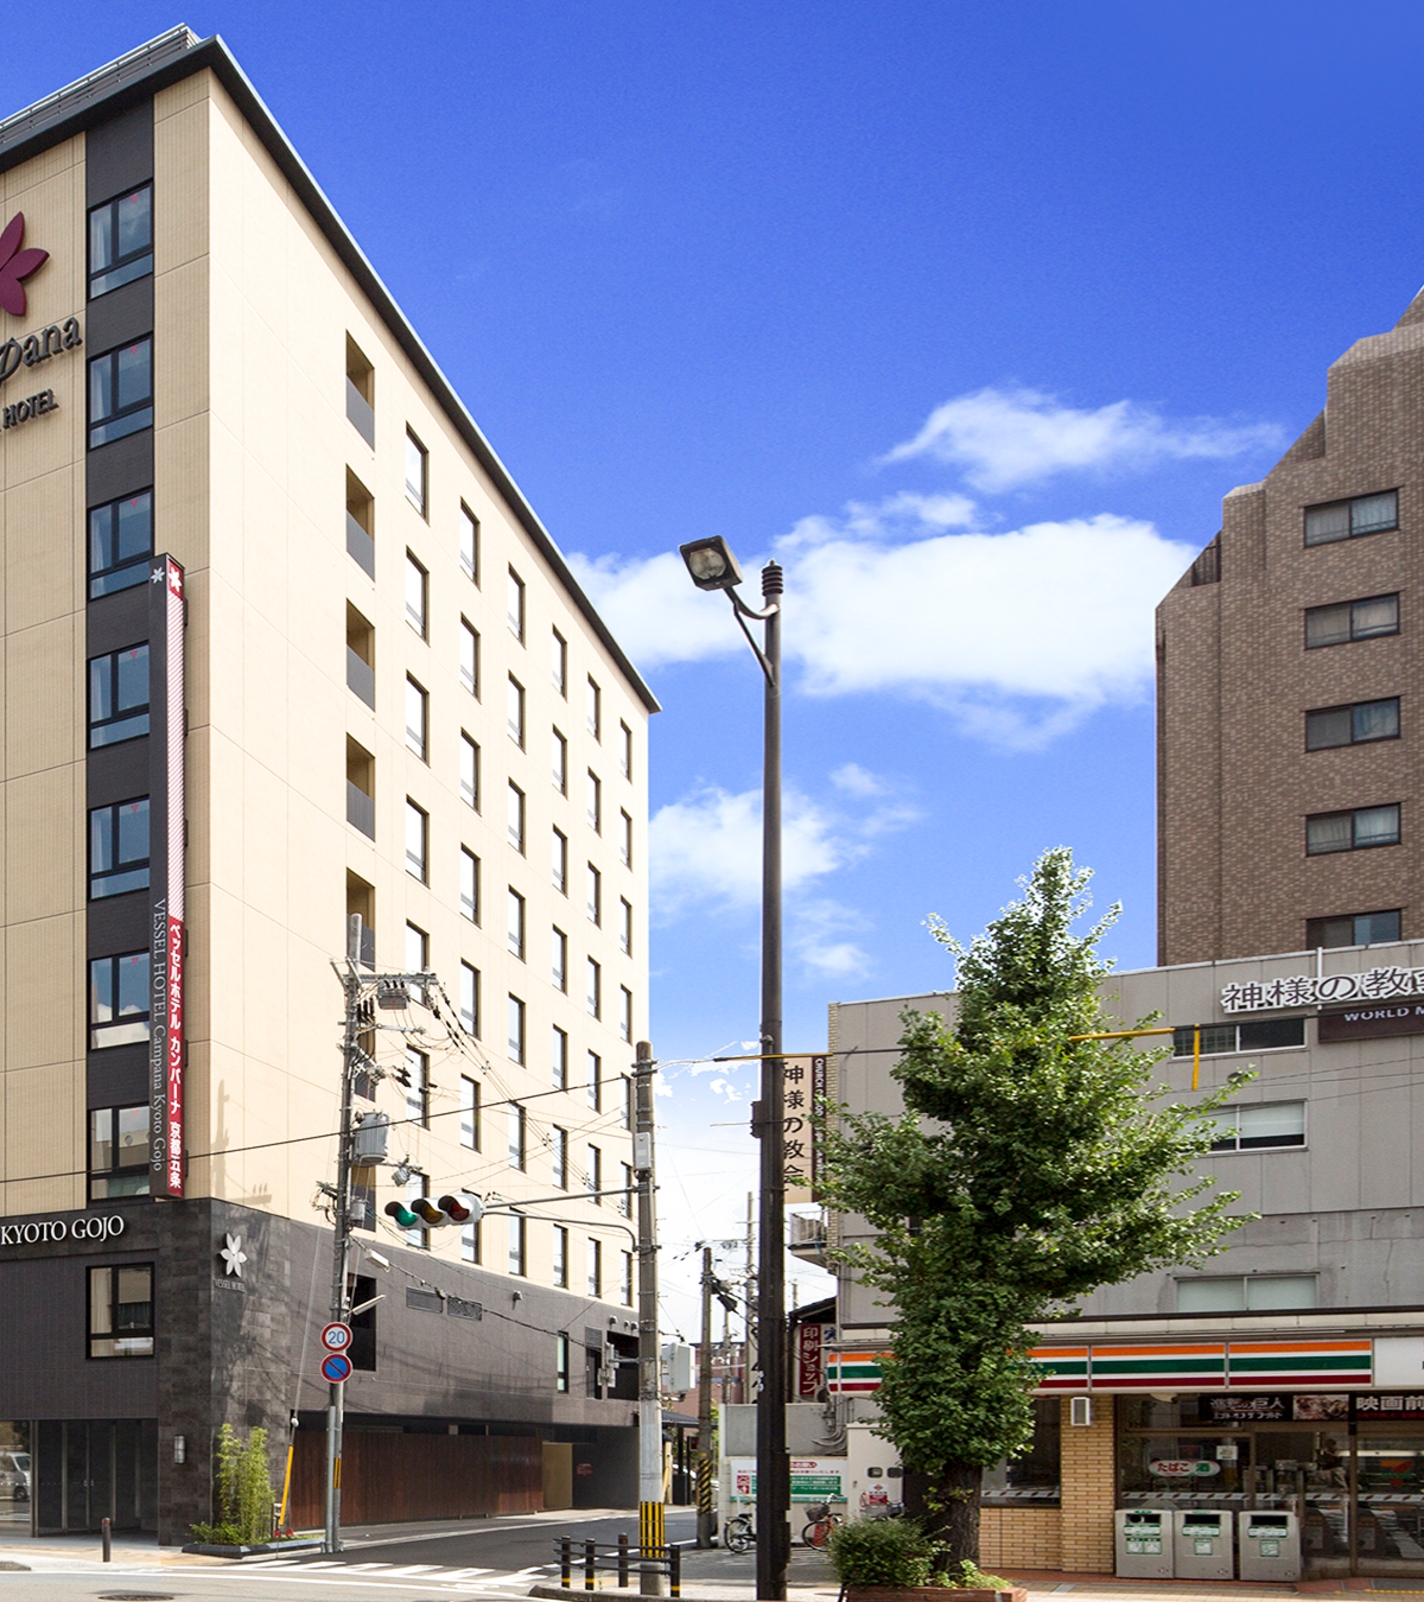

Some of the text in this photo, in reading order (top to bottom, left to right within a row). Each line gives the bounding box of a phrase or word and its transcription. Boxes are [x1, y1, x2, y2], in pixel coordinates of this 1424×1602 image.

[3, 388, 60, 429] HOTEL
[1221, 966, 1424, 1012] 神様の教
[150, 898, 166, 1171] VESSEL HOTEL Campana Kyoto Gojo
[1344, 1007, 1410, 1021] WORLD
[169, 924, 182, 1189] ベッセルホテル カンパーナ 京都五条
[0, 1220, 67, 1246] KYOTO
[71, 1215, 125, 1242] GOJO
[328, 1330, 345, 1344] 20
[802, 1327, 819, 1393] 印刷ショップ
[1157, 1463, 1190, 1472] たばこ
